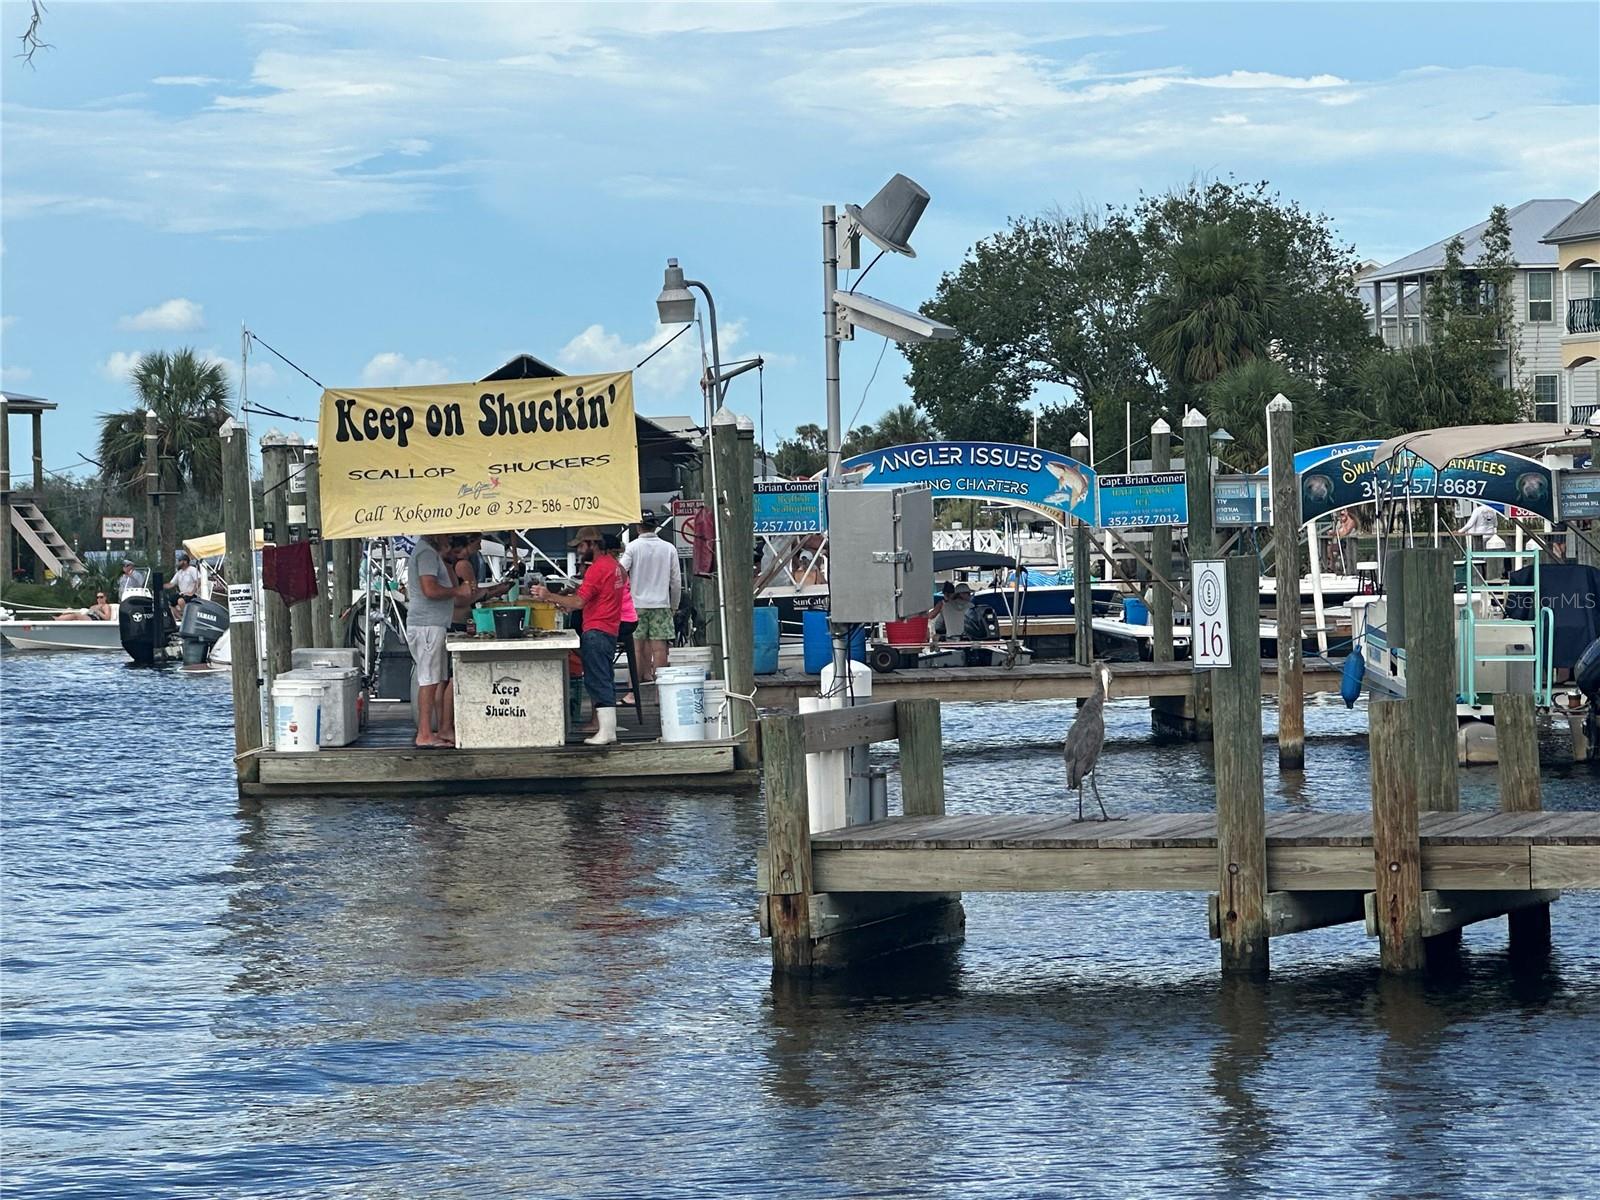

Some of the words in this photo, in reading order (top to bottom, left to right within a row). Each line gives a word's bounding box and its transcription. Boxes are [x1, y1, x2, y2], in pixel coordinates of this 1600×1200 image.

[335, 399, 414, 447] Keep
[426, 403, 465, 437] on
[478, 384, 616, 437] Shuckin'
[348, 467, 456, 480] SCALLOP
[488, 454, 610, 474] SHUCKERS
[880, 447, 963, 473] ANGLER
[970, 447, 1043, 471] ISSUES
[758, 483, 783, 492] Brian
[784, 481, 819, 491] Conner
[956, 478, 1029, 495] CHARTERS
[1100, 477, 1124, 487] Capt.
[1125, 475, 1149, 485] Brian
[1151, 474, 1184, 484] Conner
[355, 505, 387, 524] Call
[392, 503, 453, 522] Kokomo
[456, 503, 480, 519] Joe
[487, 501, 500, 516] @
[1108, 514, 1179, 526] 352.257.7012
[1200, 620, 1223, 658] 16
[492, 683, 520, 697] Keep
[485, 705, 527, 717] Shuckin
